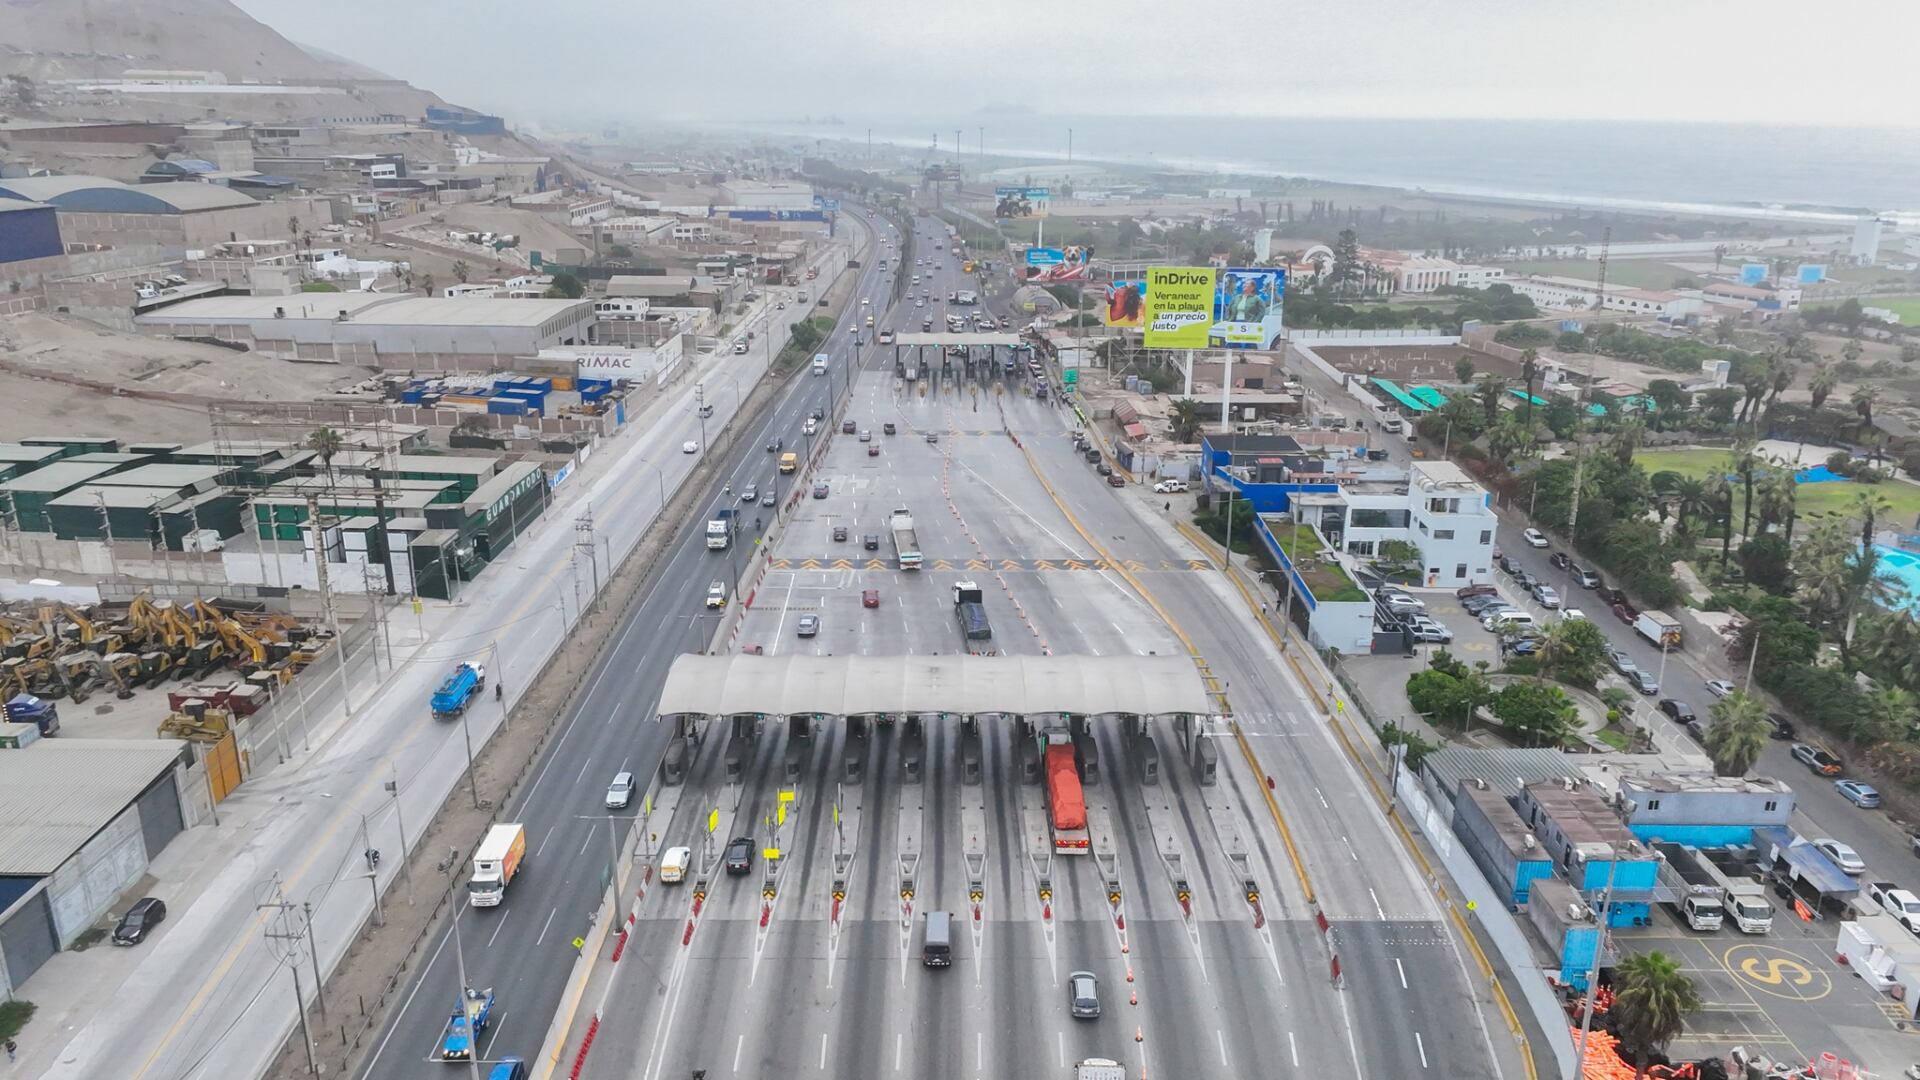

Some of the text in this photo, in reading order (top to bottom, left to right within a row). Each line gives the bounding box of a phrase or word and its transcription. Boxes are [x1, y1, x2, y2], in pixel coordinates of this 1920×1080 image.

[1155, 272, 1208, 285] inDrive
[1155, 292, 1201, 300] Veranear
[1167, 302, 1176, 310] la
[1178, 302, 1205, 312] playa
[1175, 312, 1206, 321] precio
[1152, 321, 1177, 331] justo
[576, 357, 632, 369] RIMAC
[486, 468, 541, 521] GUARDATODO
